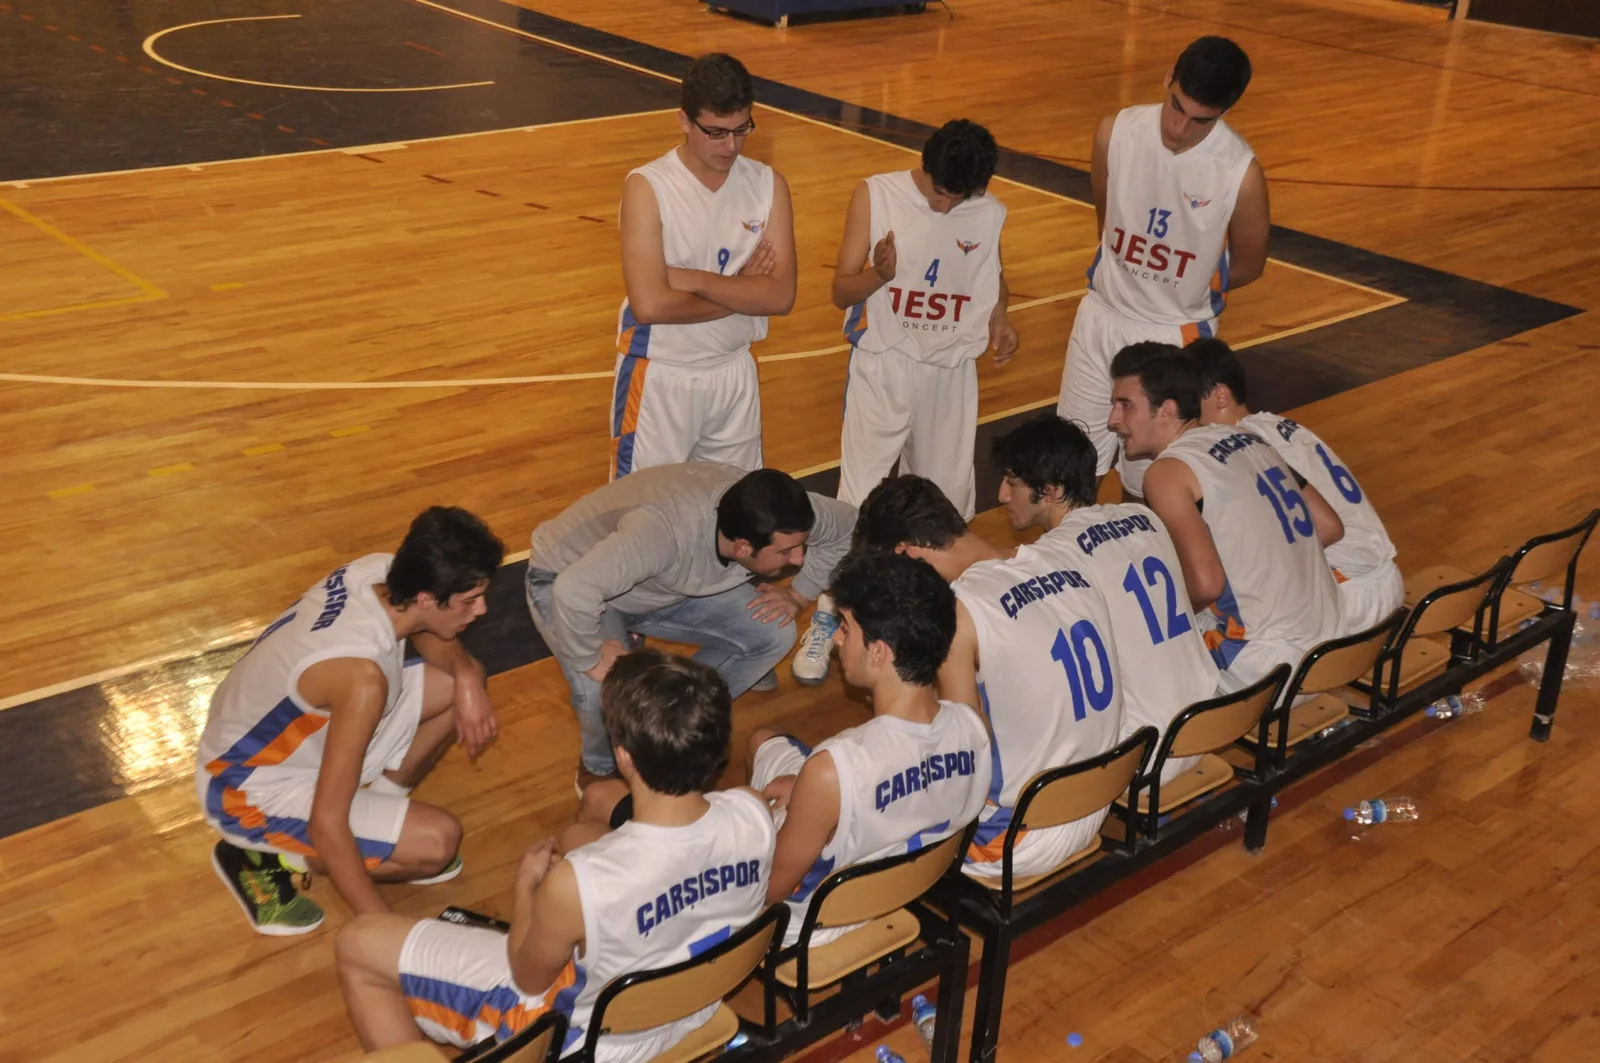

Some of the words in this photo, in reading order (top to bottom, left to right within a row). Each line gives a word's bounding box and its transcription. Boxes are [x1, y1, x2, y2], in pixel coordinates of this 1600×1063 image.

[1146, 207, 1172, 239] 13
[717, 248, 730, 275] 9
[924, 259, 940, 287] 4
[1111, 227, 1197, 278] JEST
[1115, 258, 1179, 288] CONCEPT
[888, 286, 971, 322] JEST
[902, 321, 957, 333] ONCEPT
[1315, 443, 1362, 504] 6
[1257, 466, 1313, 544] 15
[1123, 556, 1192, 645] 12
[1050, 619, 1113, 722] 10
[637, 860, 760, 939] ÇARŞISPOR
